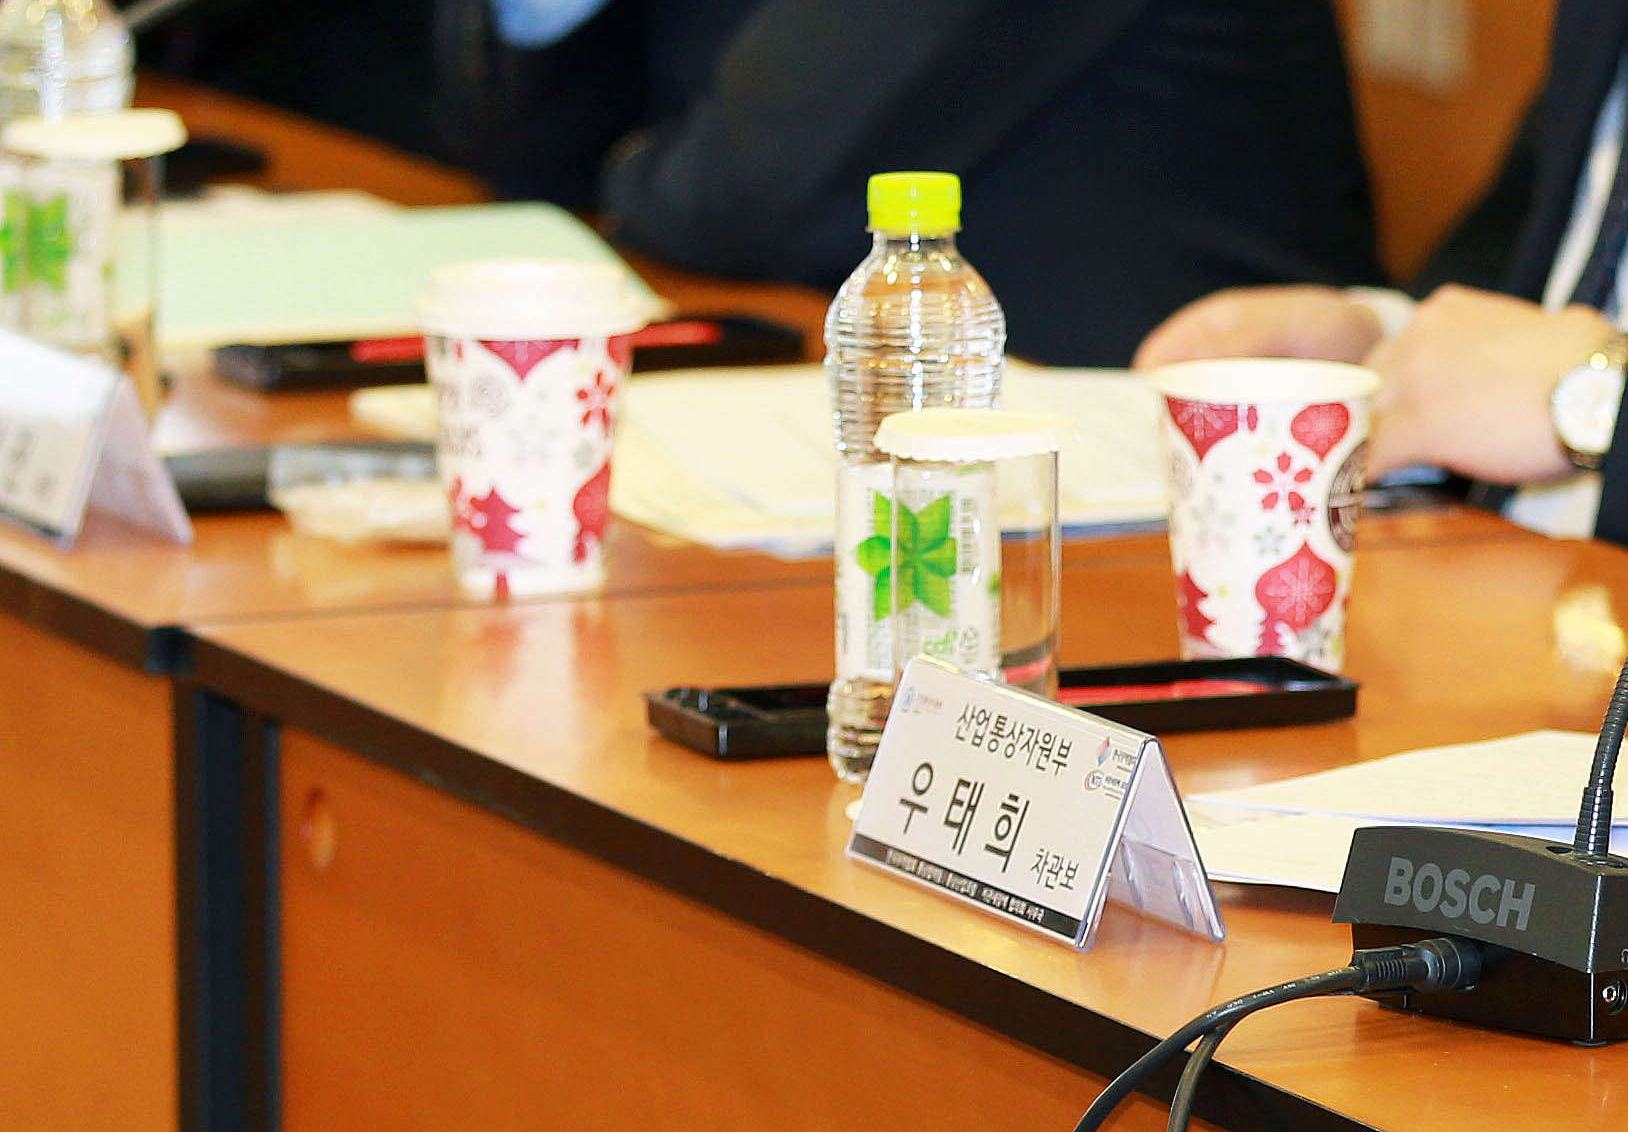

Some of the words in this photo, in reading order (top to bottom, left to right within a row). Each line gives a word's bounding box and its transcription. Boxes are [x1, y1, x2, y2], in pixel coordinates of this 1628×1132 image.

[956, 703, 1073, 776] 산업통상자원부
[1030, 847, 1079, 892] 차관보
[1383, 856, 1536, 932] BOSCH
